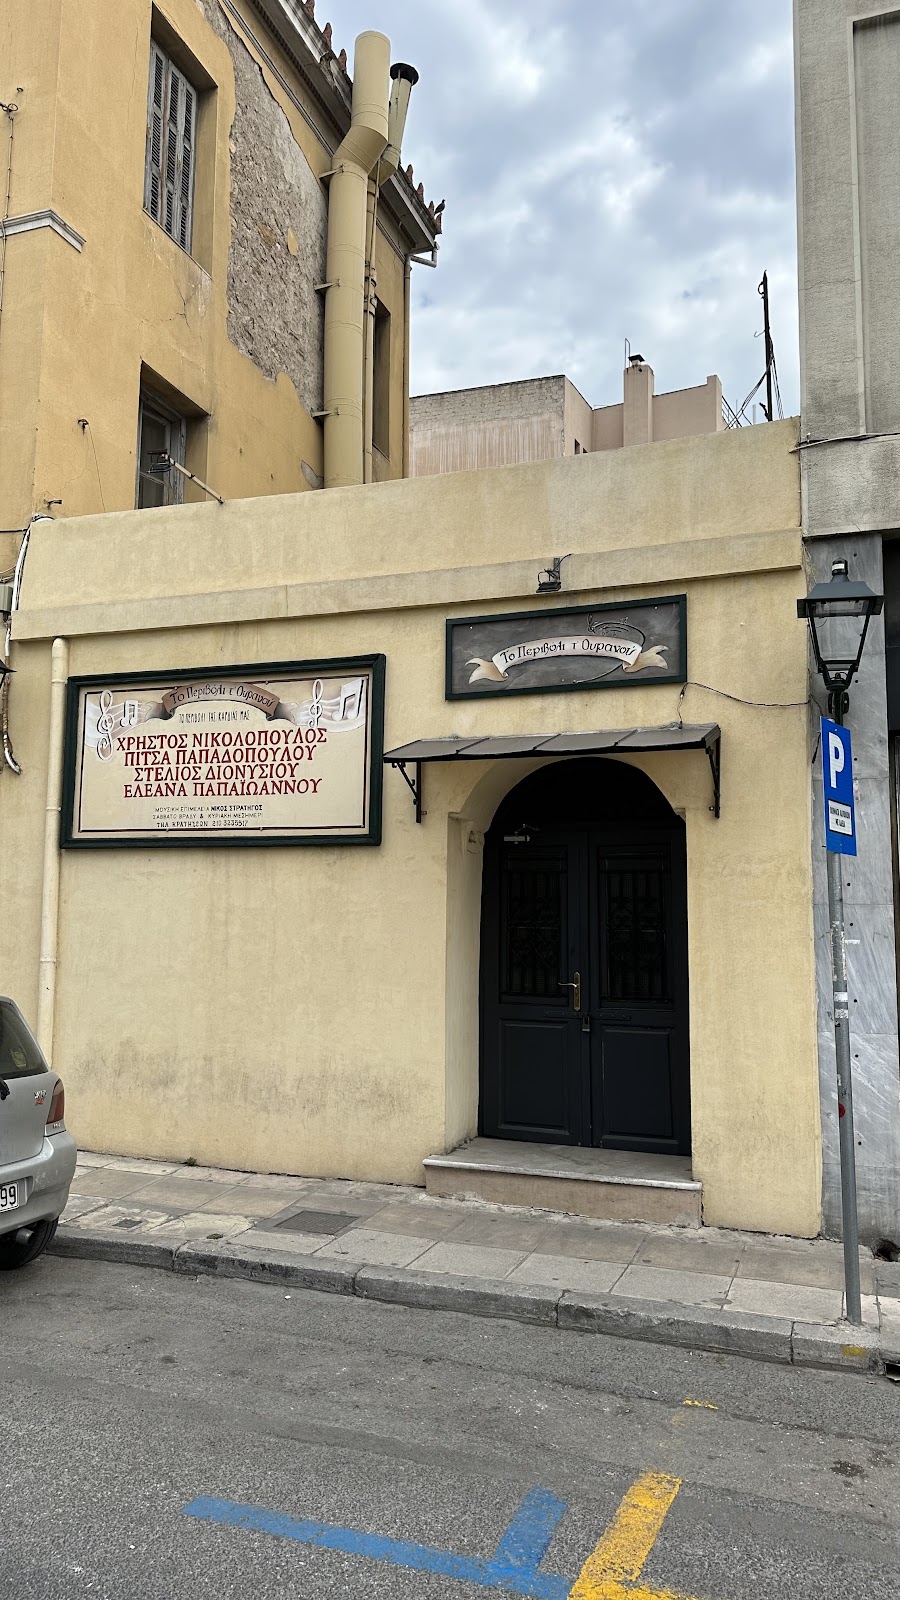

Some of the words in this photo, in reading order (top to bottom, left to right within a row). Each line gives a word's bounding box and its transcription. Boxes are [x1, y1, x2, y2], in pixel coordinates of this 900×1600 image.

[517, 641, 566, 659] Περιβόλι
[581, 638, 637, 656] Ουρανού
[170, 691, 185, 705] Το
[186, 684, 226, 699] Περιβόλι
[236, 685, 274, 708] Ουρανού
[117, 734, 188, 751] ΧΡΗΣΤΟΣ
[192, 727, 328, 748] ΝΙΚΟΛΟΠΟΥΛΟΣ
[124, 750, 172, 767] ΠΙΤΣΑ
[175, 745, 317, 765] ΠΑΠΑΔΟΠΟΥΛΟΥ
[828, 731, 845, 789] P
[134, 766, 202, 782] ΣΤΕΛΙΟΣ
[205, 762, 299, 781] ΔΙΟΝΥΣΙΟΥ
[123, 782, 188, 798] ΕΛΕΑΝΑ
[193, 778, 323, 797] ΠΑΠΑΪΩΑΝΝΟΥ
